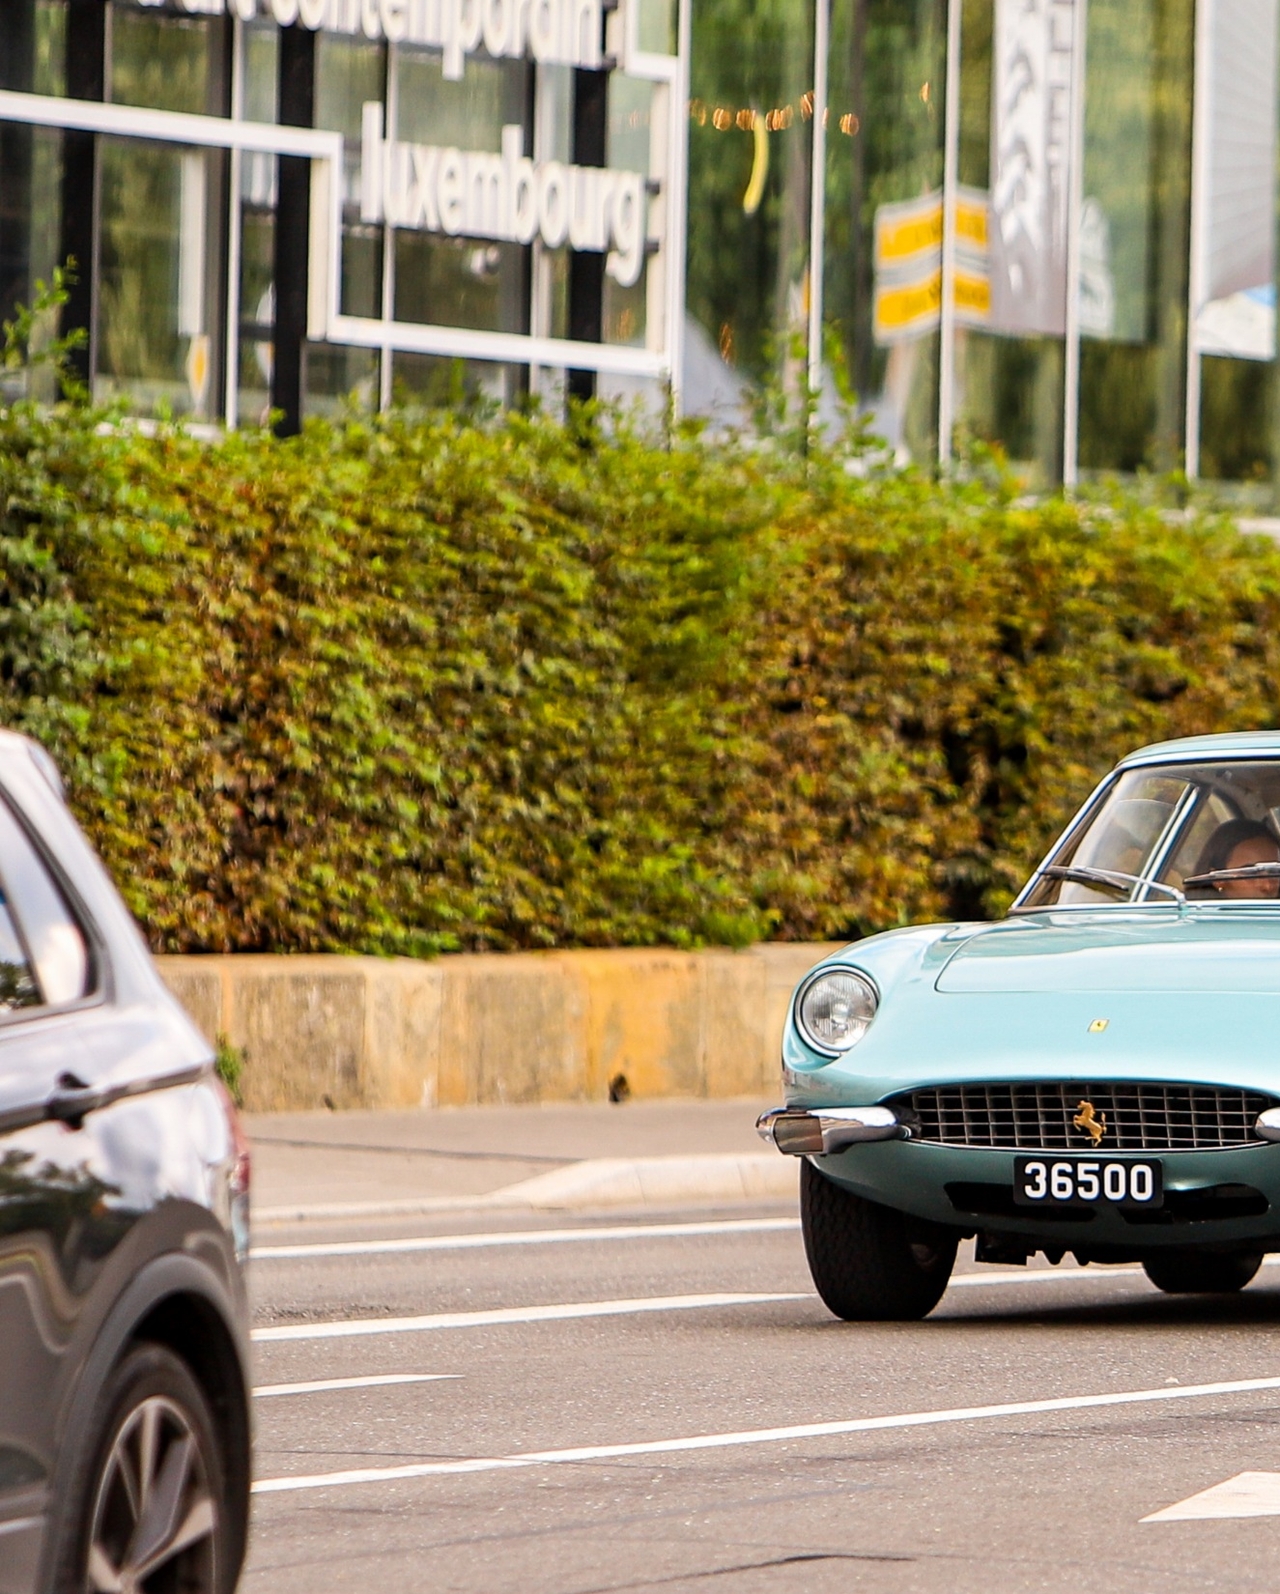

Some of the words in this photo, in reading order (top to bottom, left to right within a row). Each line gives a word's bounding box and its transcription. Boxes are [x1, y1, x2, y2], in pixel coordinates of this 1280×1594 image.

[271, 0, 603, 81] mporain
[360, 101, 645, 287] luxembourg
[1024, 1161, 1154, 1201] 36500
